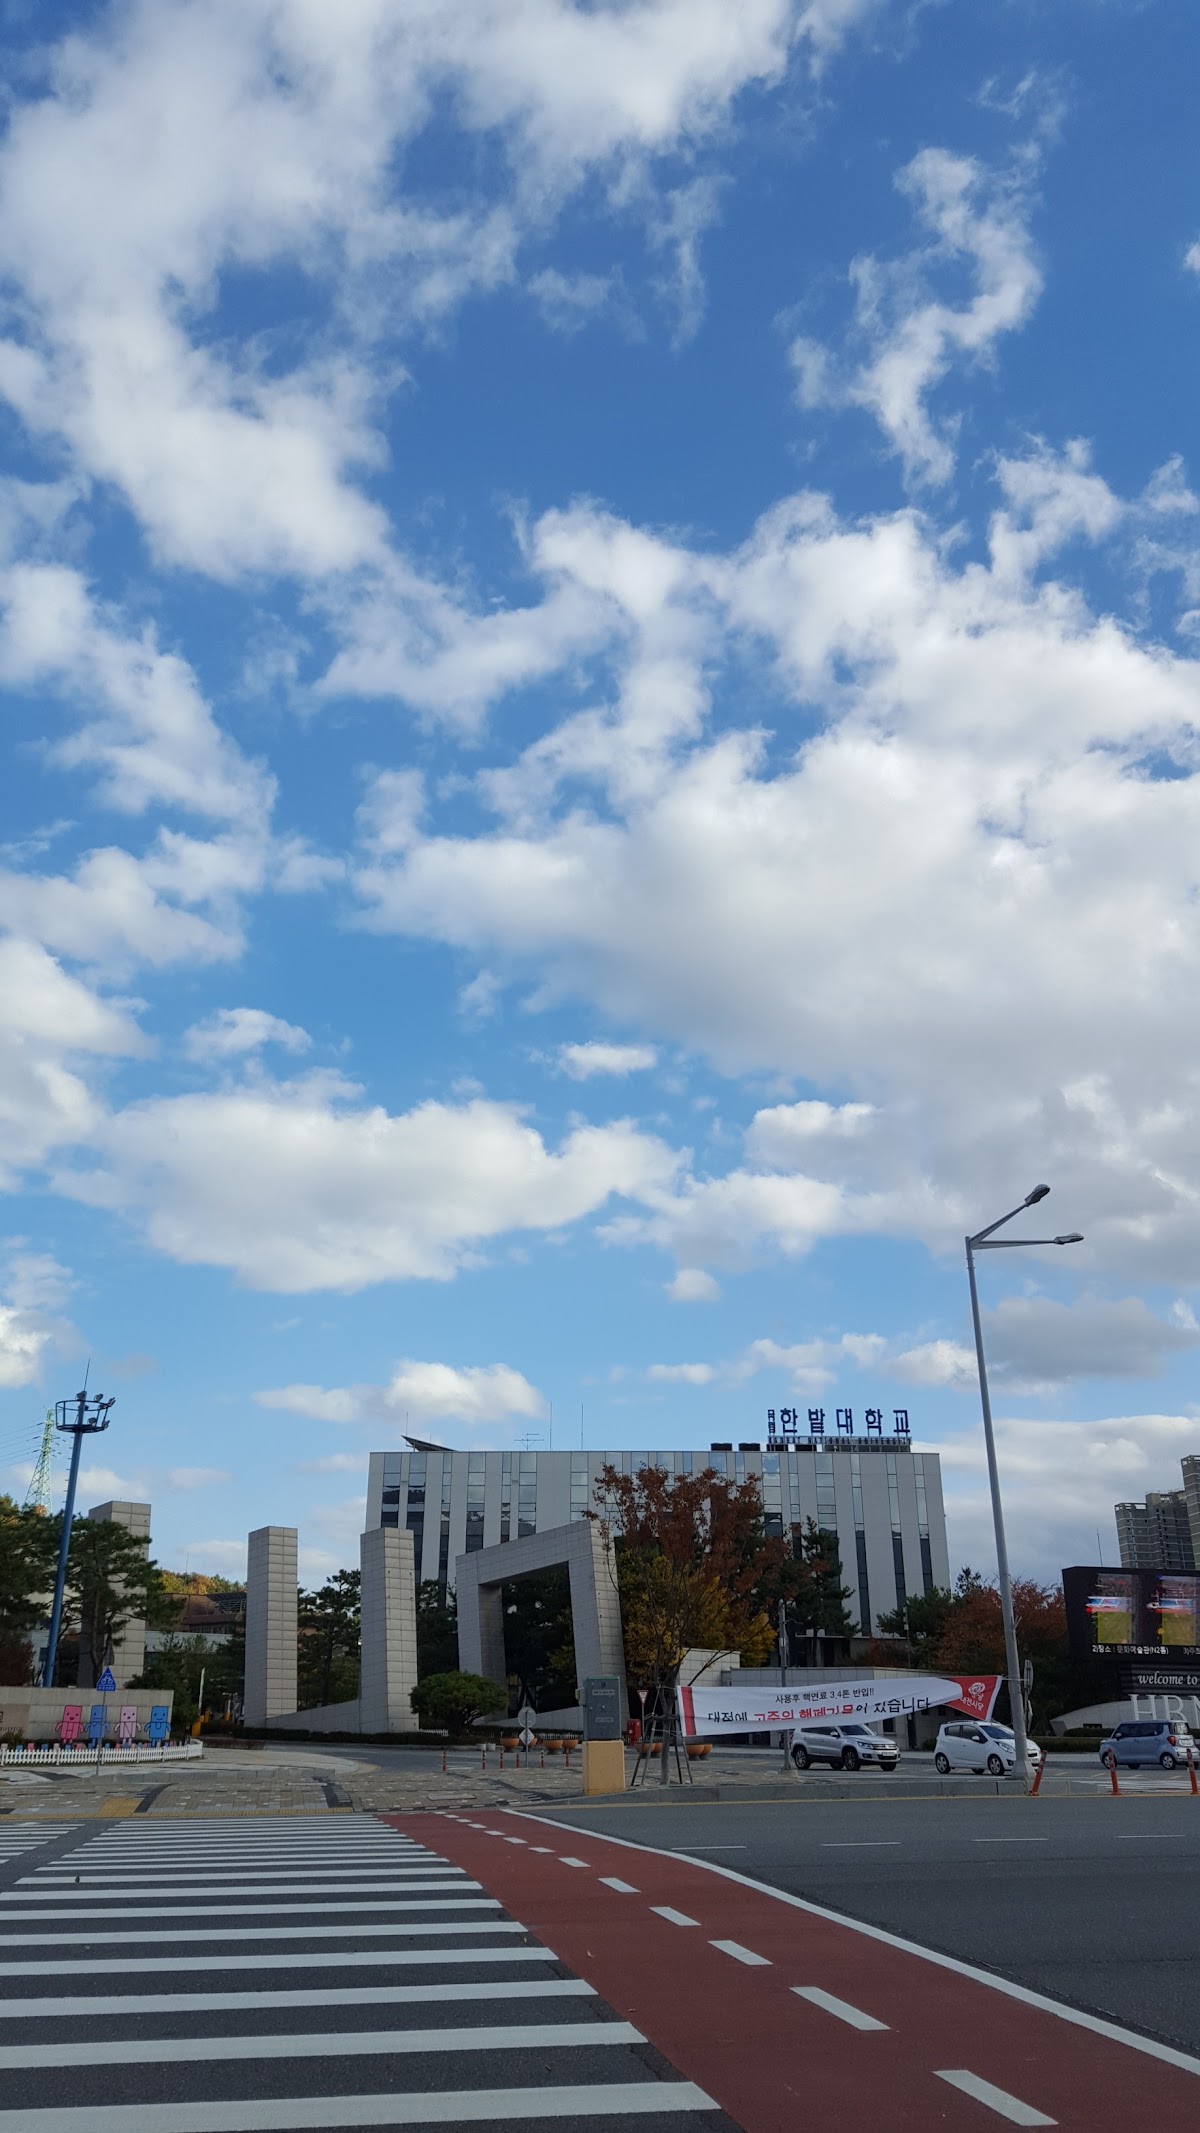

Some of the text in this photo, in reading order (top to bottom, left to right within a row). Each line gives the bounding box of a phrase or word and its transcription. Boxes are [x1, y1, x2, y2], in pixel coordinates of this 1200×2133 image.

[780, 1408, 910, 1434] 한밭대학교
[1137, 1671, 1198, 1685] welcome to
[776, 1693, 800, 1704] 사용후
[802, 1691, 827, 1702] 핵연료
